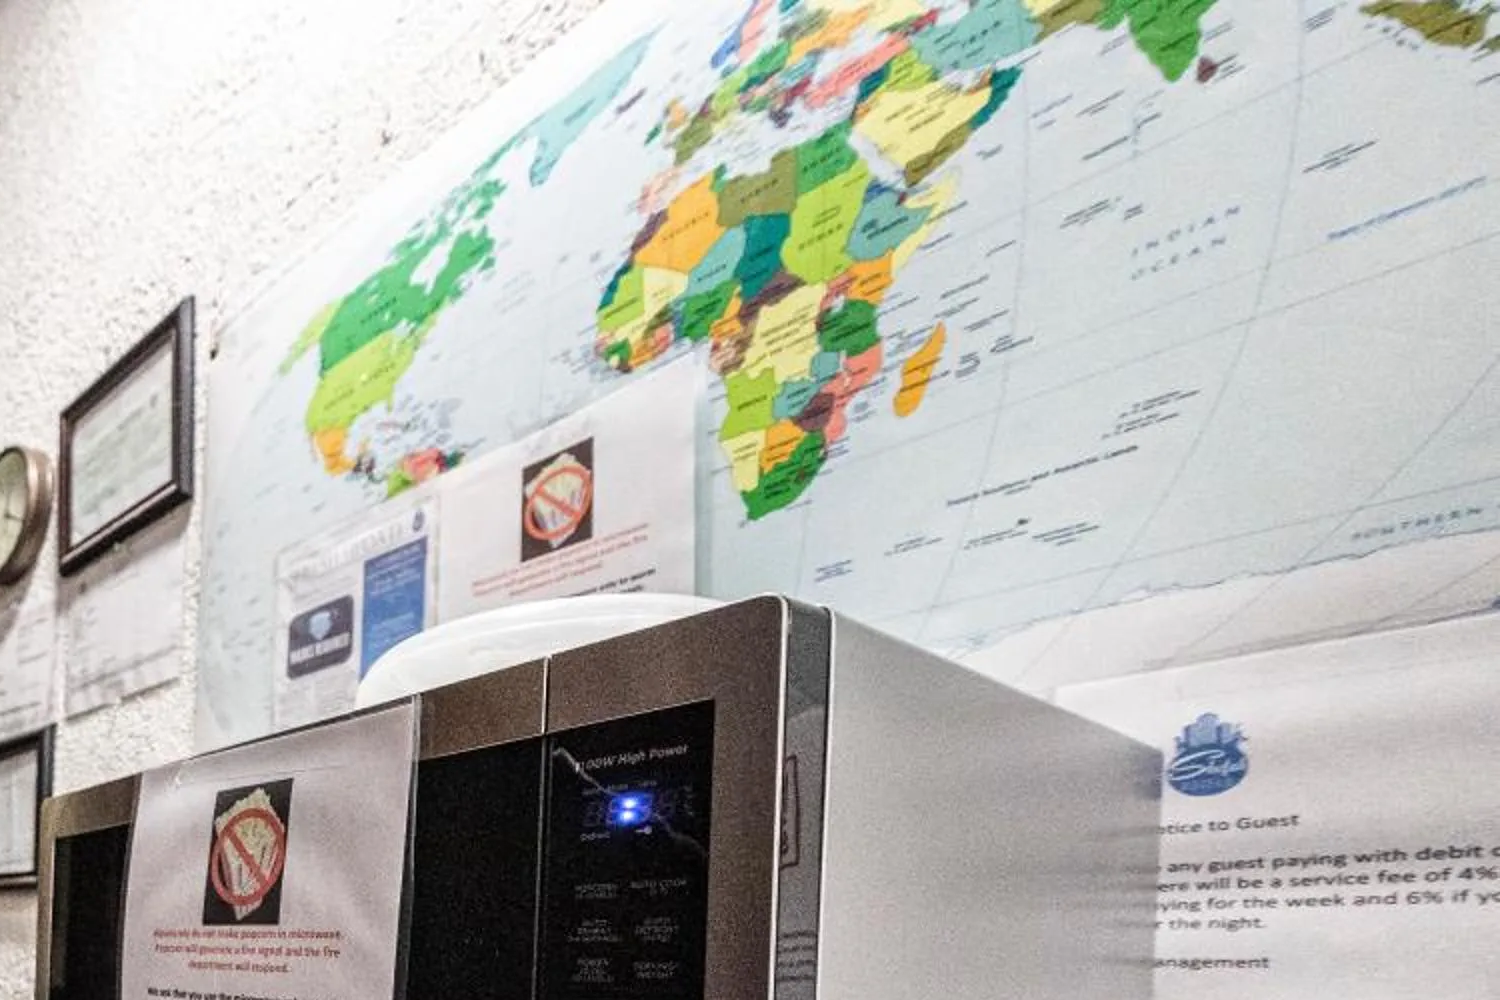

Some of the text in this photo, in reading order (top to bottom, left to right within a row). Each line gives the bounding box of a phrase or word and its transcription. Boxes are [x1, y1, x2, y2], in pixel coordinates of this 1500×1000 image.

[1155, 815, 1300, 835] otice to Guest
[1167, 862, 1203, 874] any
[1208, 857, 1265, 874] guest
[1272, 852, 1348, 870] paying
[1353, 849, 1408, 863] with
[1415, 845, 1485, 861] debit
[1196, 877, 1231, 891] will
[1237, 877, 1264, 889] be
[1270, 878, 1283, 888] a
[1289, 874, 1370, 887] service
[1377, 870, 1417, 884] fee
[1424, 867, 1453, 882] of
[1457, 866, 1500, 881] 4%
[1207, 897, 1238, 909] for
[1243, 896, 1279, 908] the
[1285, 894, 1346, 907] week
[1351, 892, 1398, 906] and
[1406, 891, 1445, 905] 6%
[1452, 889, 1471, 903] if
[1168, 917, 1202, 930] the
[1208, 917, 1268, 932] night.
[1154, 957, 1270, 970] anagement
